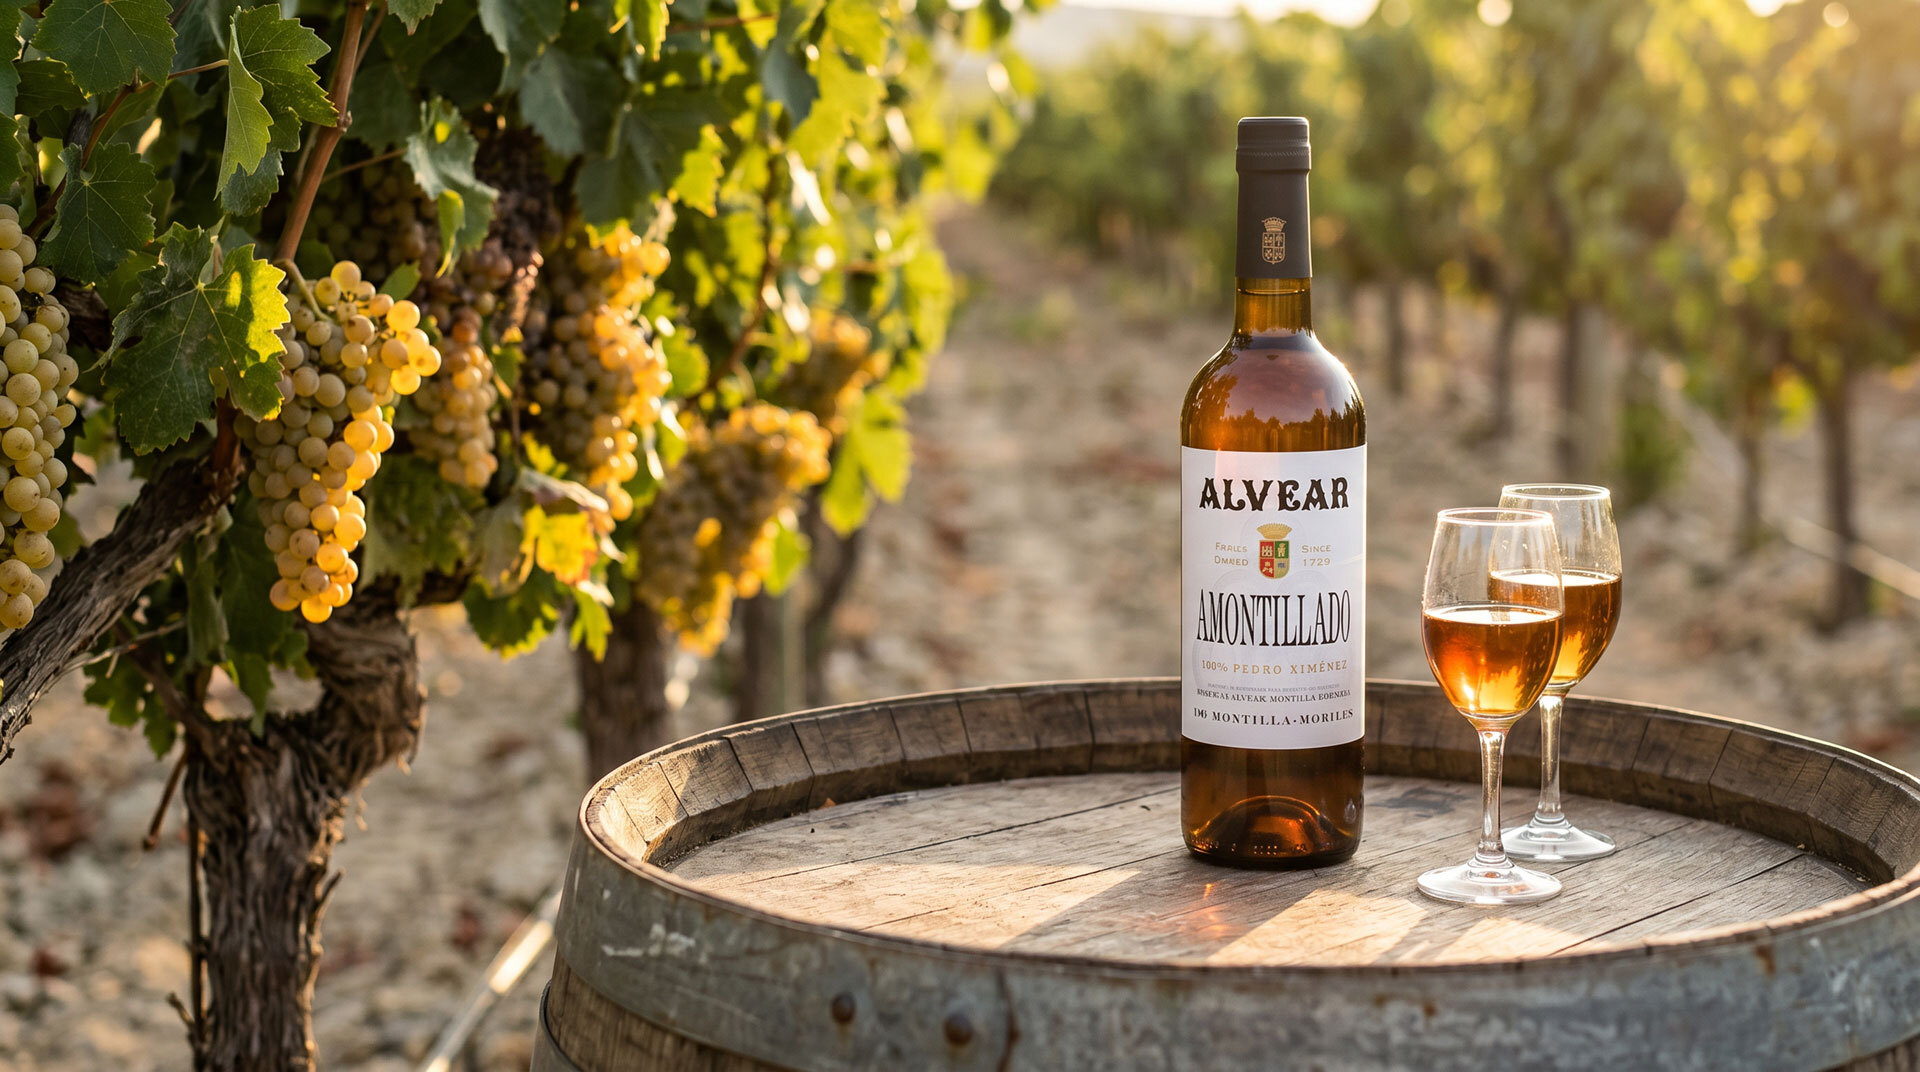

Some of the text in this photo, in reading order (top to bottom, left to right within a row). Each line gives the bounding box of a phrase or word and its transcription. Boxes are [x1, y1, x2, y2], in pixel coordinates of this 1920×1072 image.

[1199, 477, 1349, 511] ALVEAR
[1301, 544, 1331, 554] SINCE
[1303, 557, 1331, 567] 1729
[1196, 588, 1351, 646] AMONTILLADO
[1201, 659, 1348, 674] 100% PEDRO XIMÉNEZ
[1269, 694, 1316, 703] MONTILLA
